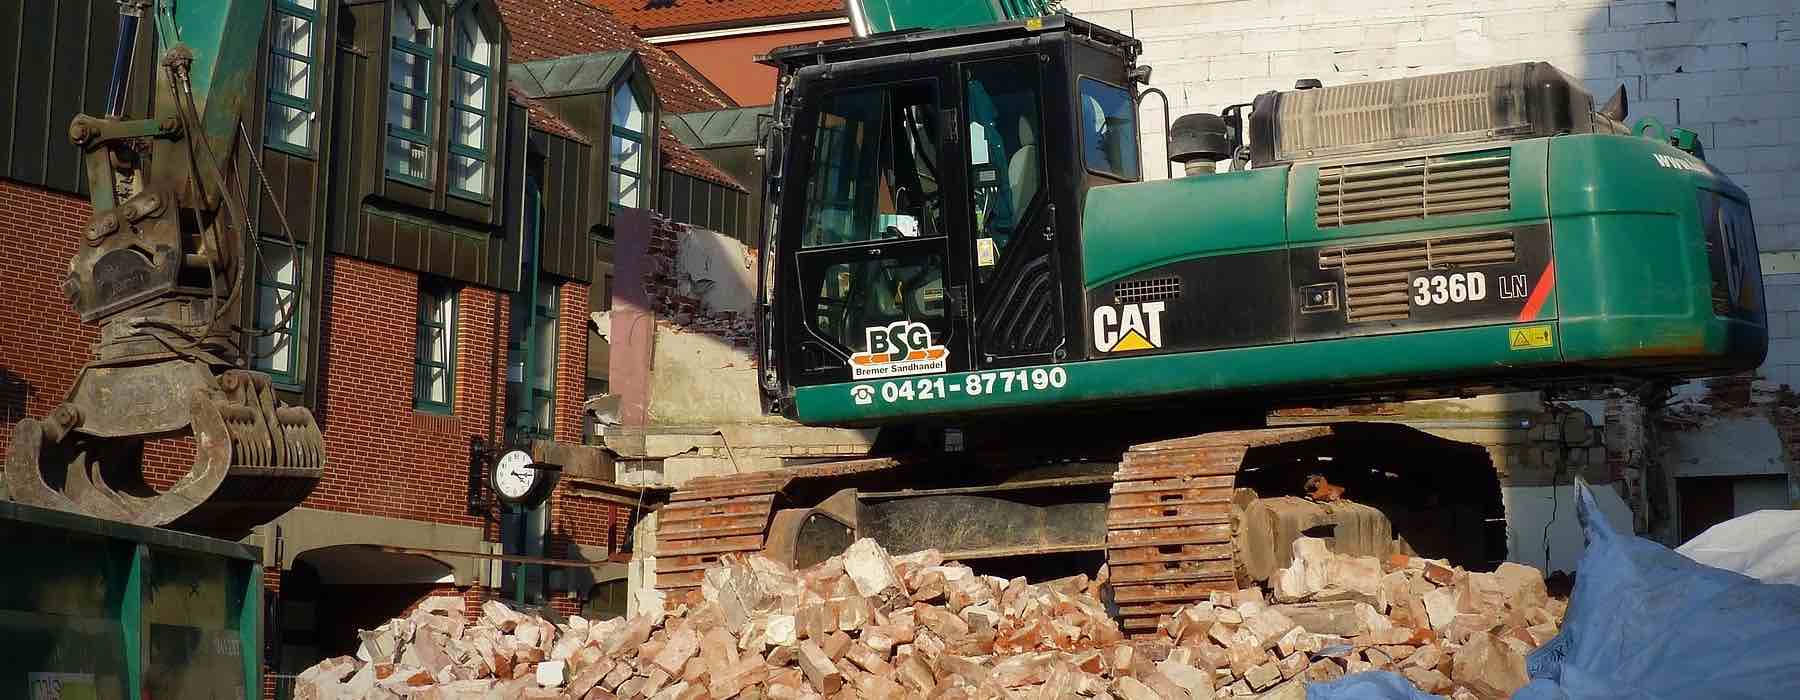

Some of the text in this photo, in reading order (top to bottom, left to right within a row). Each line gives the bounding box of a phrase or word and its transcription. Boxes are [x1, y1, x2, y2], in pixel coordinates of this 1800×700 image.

[1413, 271, 1528, 306] 336D LN
[869, 324, 929, 362] BSG
[1093, 301, 1166, 353] CAT
[856, 360, 943, 376] Bremer Sandhandel
[881, 366, 1067, 403] 0421-877190
